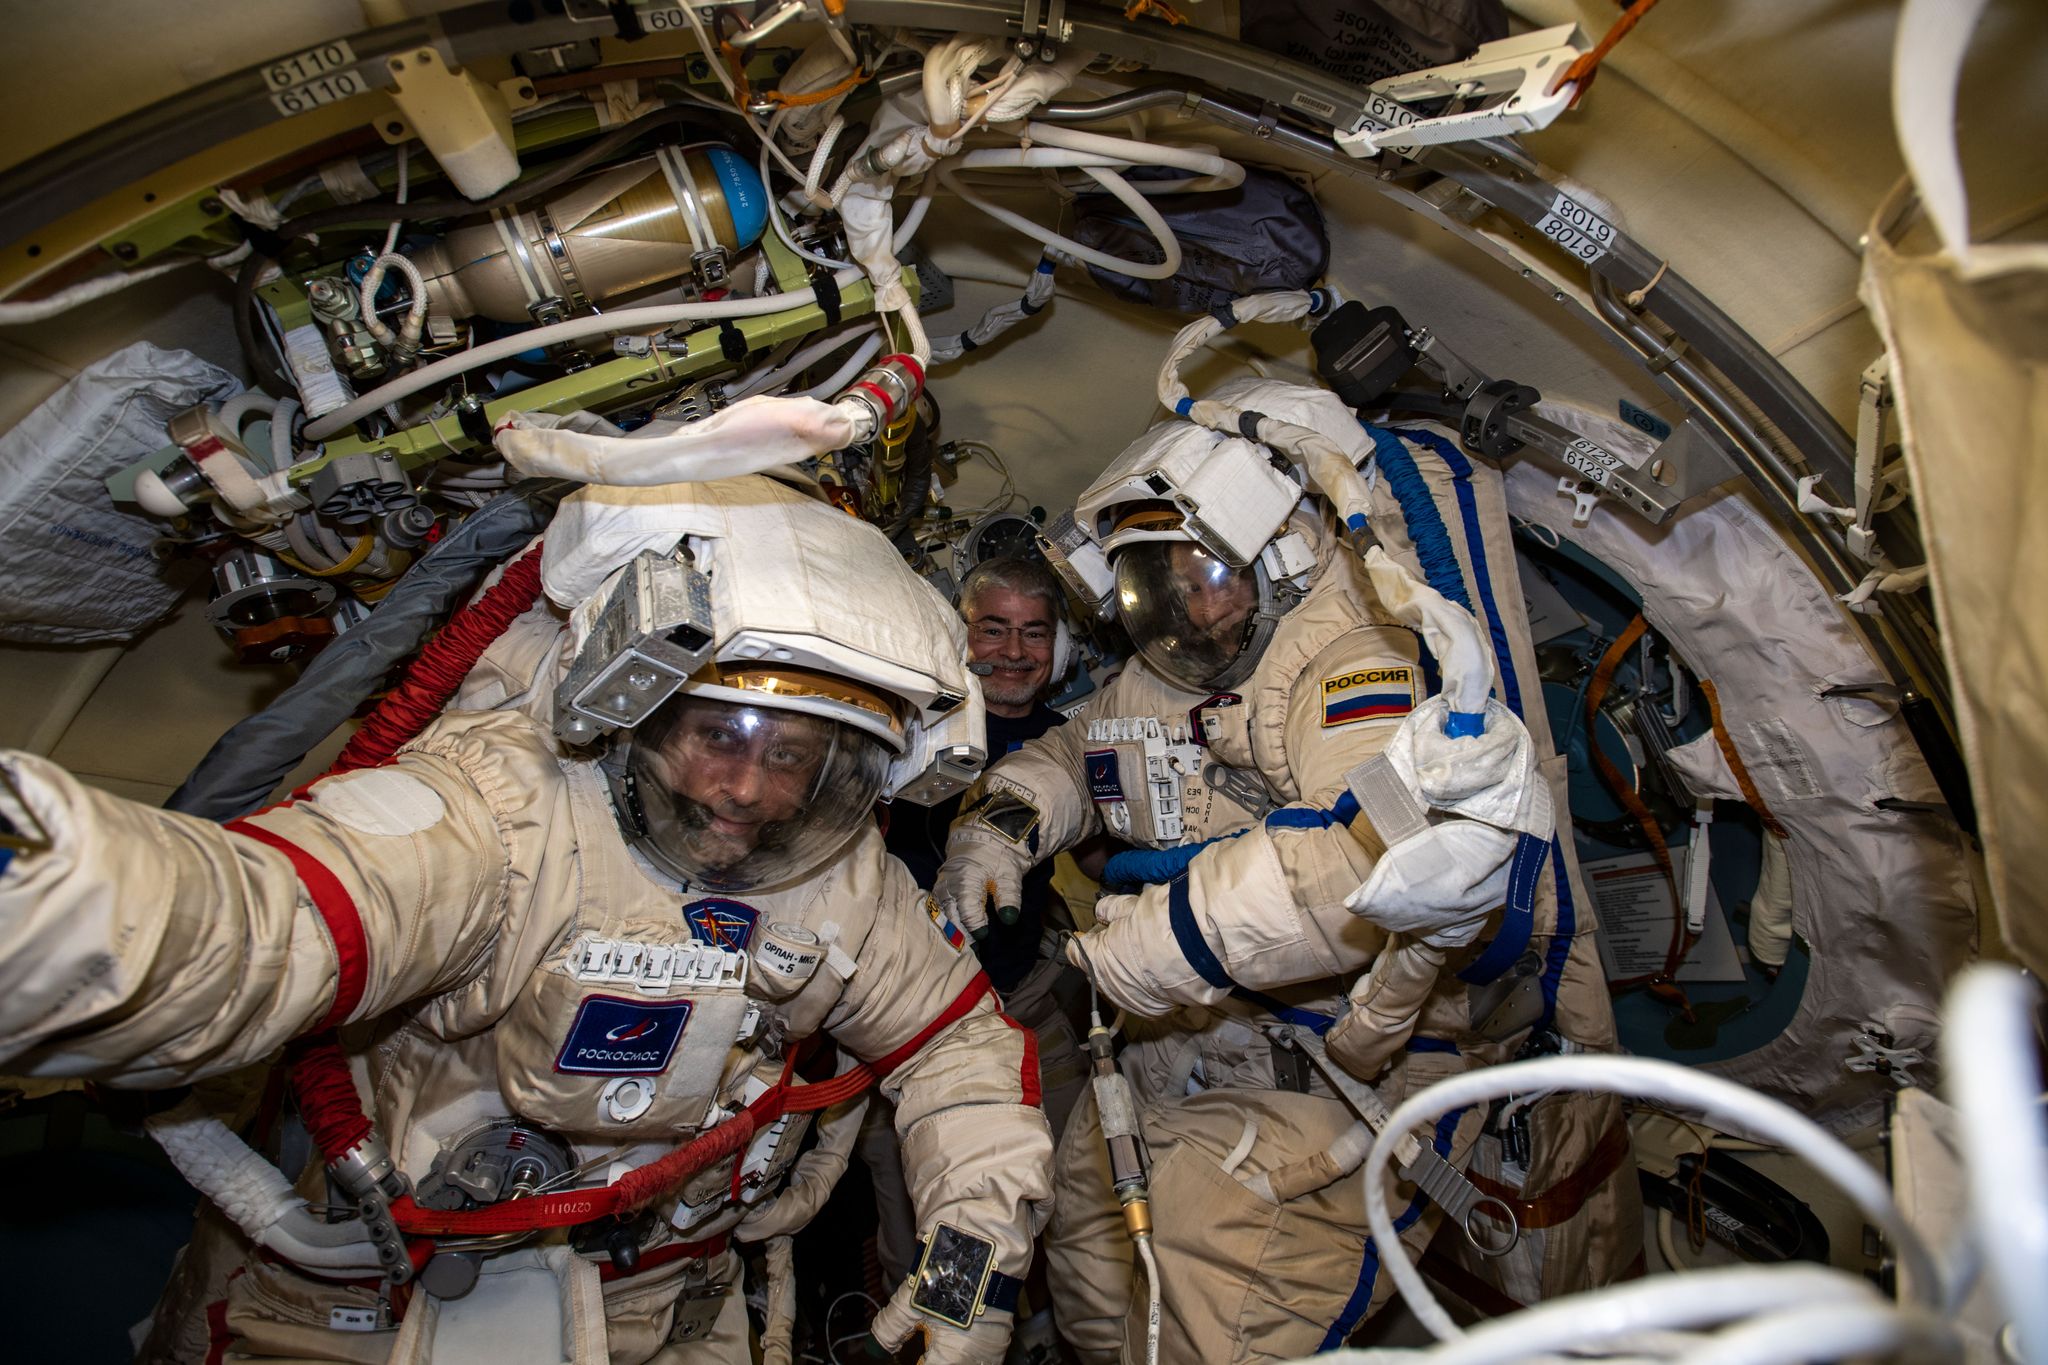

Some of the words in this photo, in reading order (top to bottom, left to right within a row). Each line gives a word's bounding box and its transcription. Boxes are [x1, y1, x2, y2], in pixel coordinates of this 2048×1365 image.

[1332, 9, 1381, 33] HOSE
[270, 46, 344, 87] 6110
[280, 75, 356, 112] 6110
[1559, 198, 1611, 243] 6108
[1544, 218, 1598, 262] 6108
[1566, 451, 1605, 482] 6123
[1576, 438, 1617, 467] 6123
[1326, 669, 1408, 692] РОССИЯ
[764, 942, 794, 961] ОРЛАН
[798, 954, 816, 965] МКС
[786, 963, 795, 974] 5
[576, 1047, 661, 1062] РОСКОСМОС
